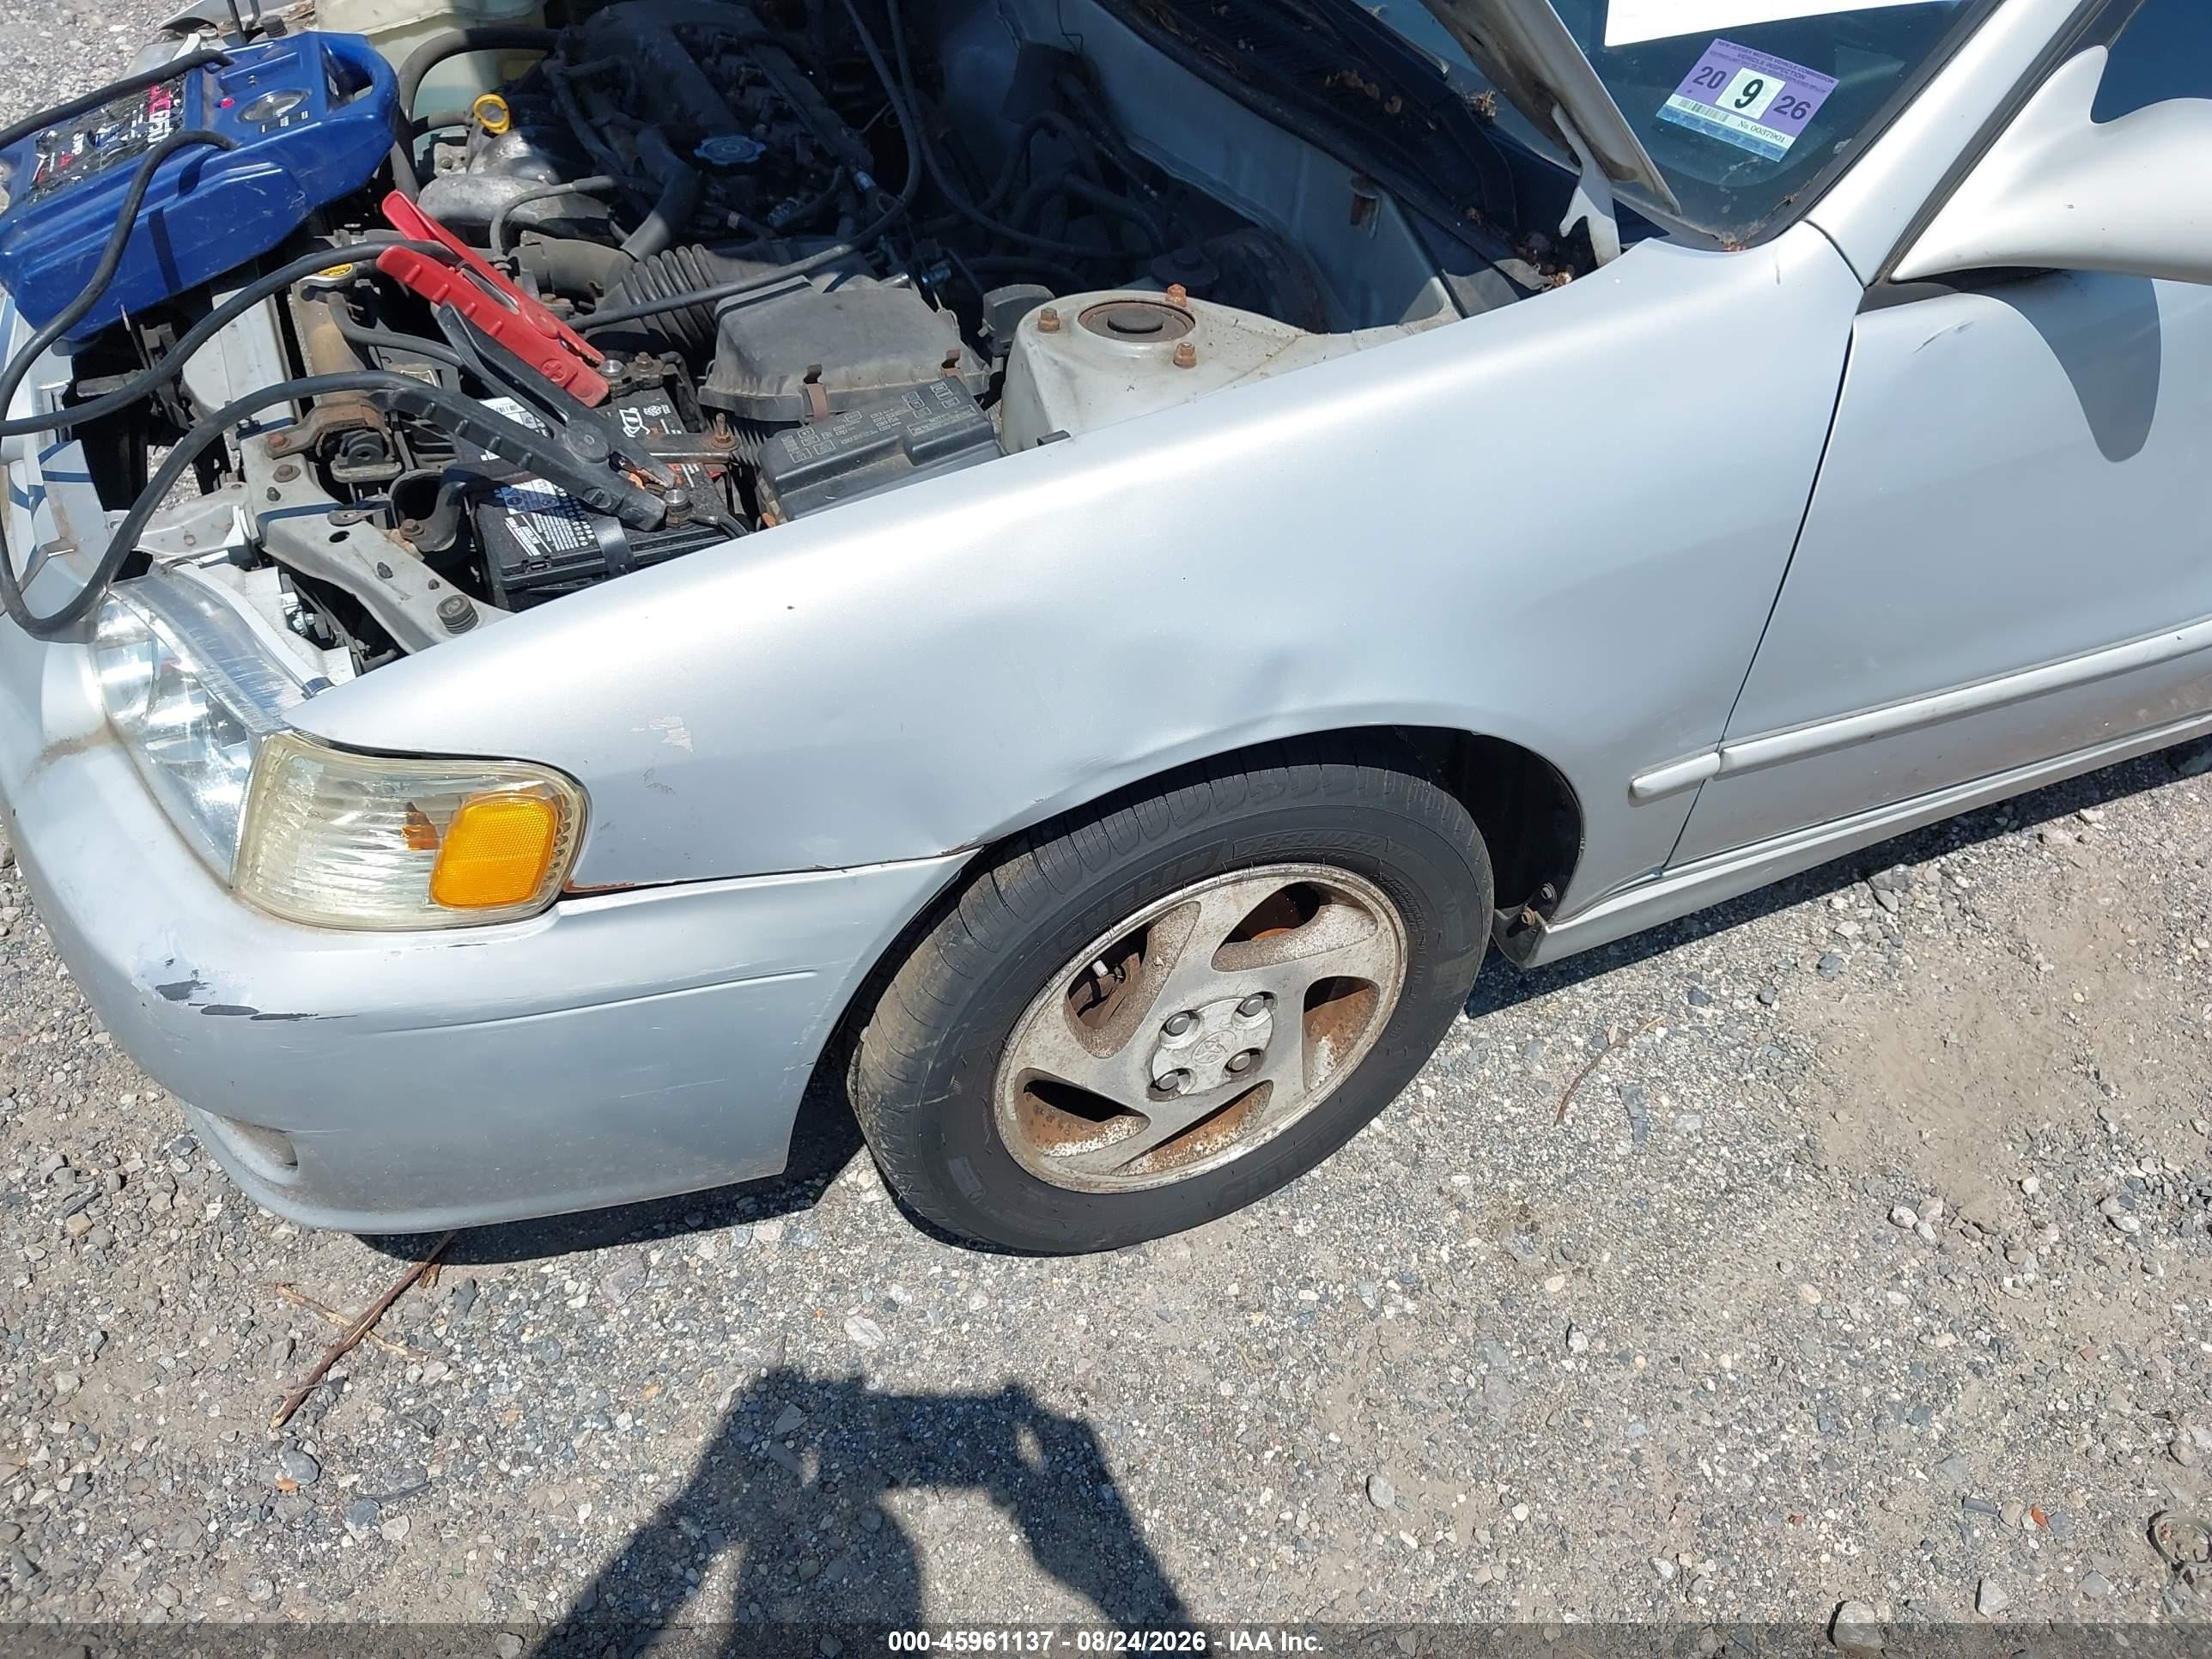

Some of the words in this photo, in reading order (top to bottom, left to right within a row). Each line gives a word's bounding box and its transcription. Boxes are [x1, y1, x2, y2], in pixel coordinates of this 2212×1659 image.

[1765, 62, 1807, 79] INSPECTION
[1692, 66, 1726, 90] 20
[1735, 79, 1764, 109] 9
[1773, 95, 1812, 120] 26
